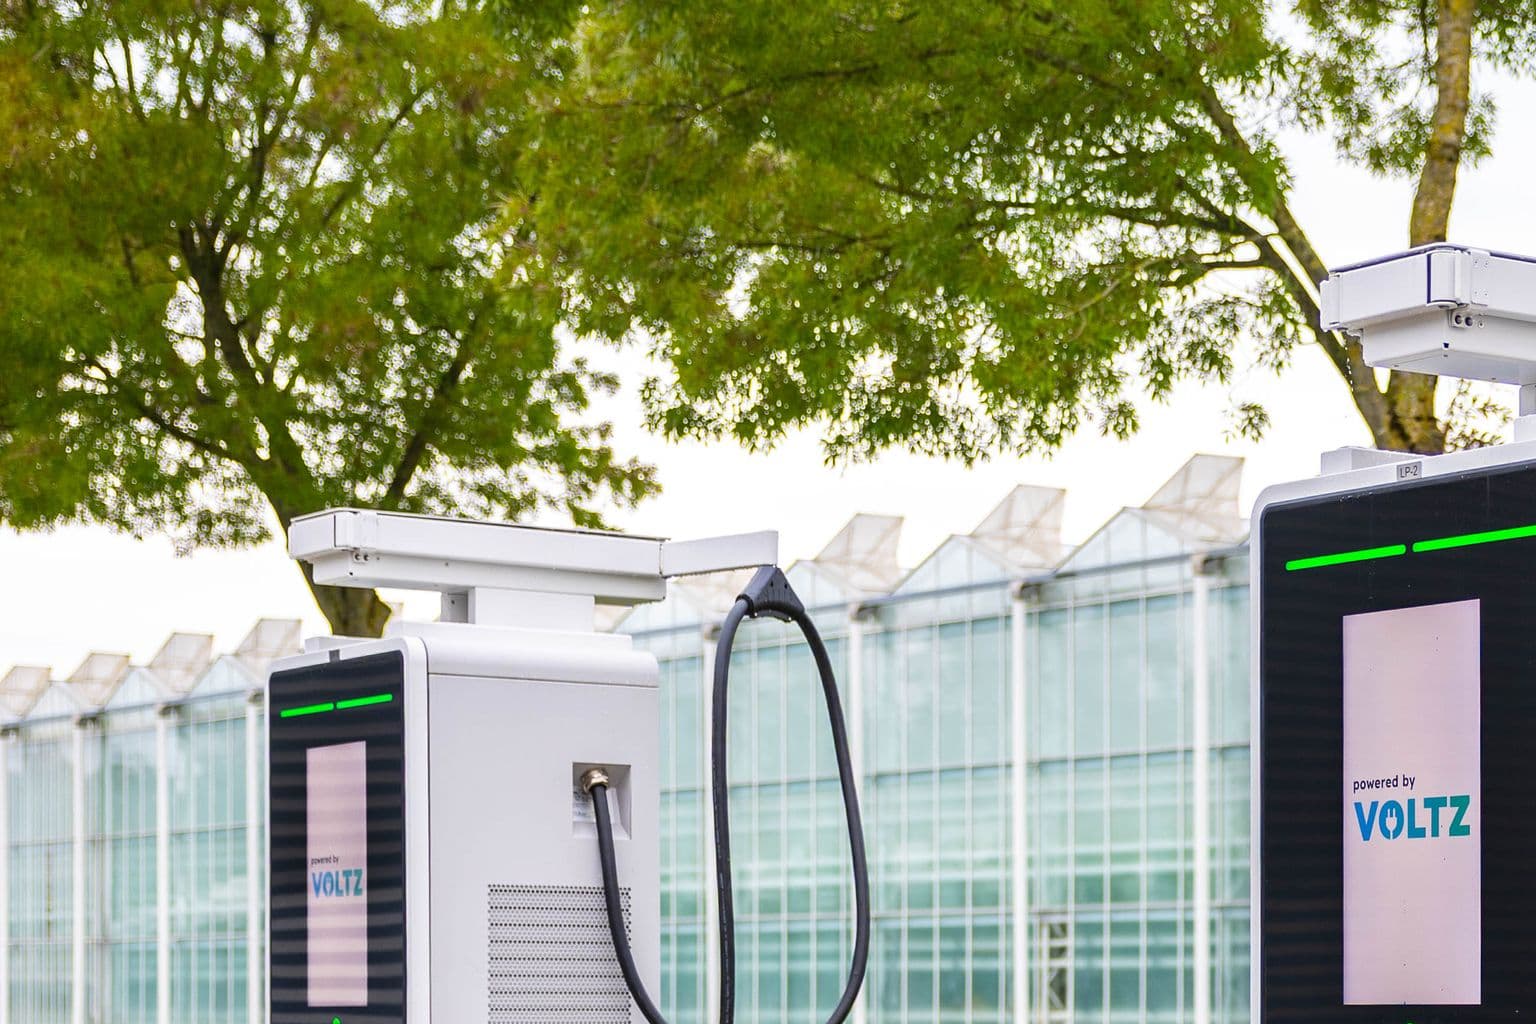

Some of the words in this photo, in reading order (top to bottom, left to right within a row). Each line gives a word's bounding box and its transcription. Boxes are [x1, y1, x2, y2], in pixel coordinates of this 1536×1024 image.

[1353, 775, 1399, 794] powered
[1402, 774, 1415, 790] by
[1354, 795, 1470, 841] VOLTZ
[312, 869, 362, 898] VOLTZ
